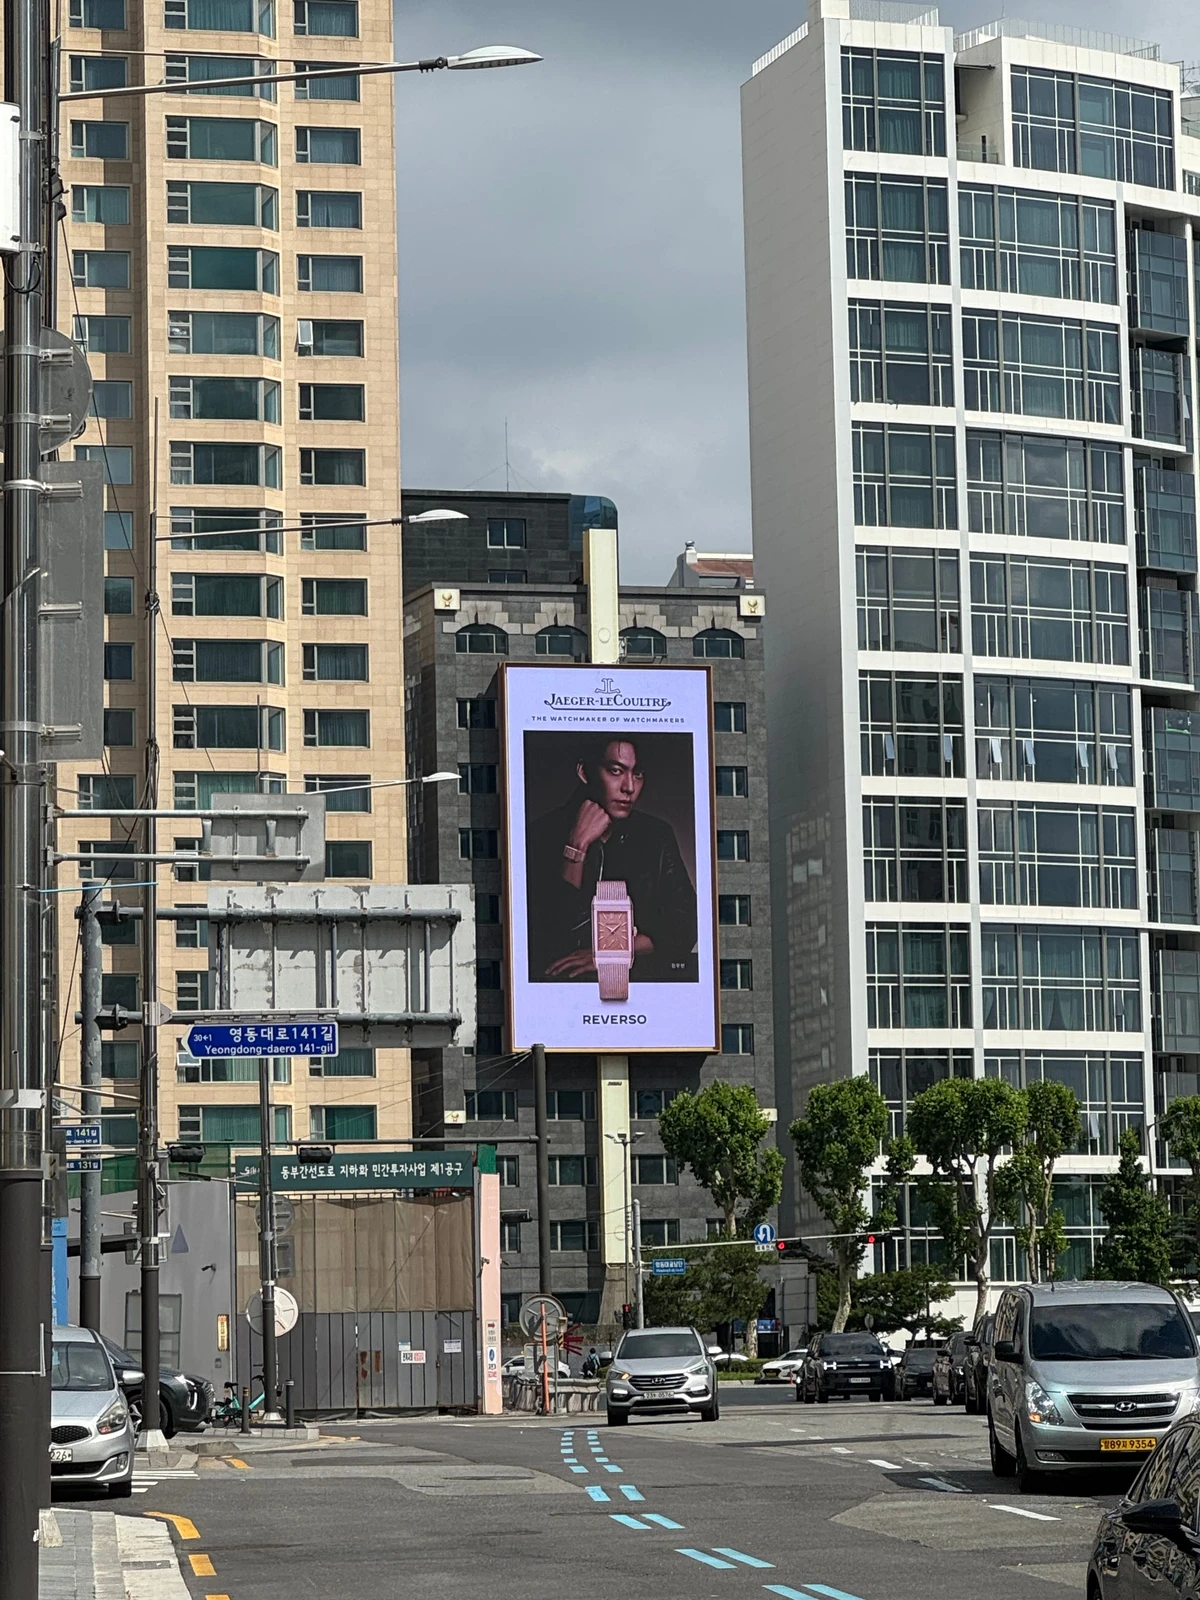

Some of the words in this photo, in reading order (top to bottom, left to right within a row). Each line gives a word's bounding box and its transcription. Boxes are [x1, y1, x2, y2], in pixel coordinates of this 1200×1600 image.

[582, 1014, 647, 1025] REVERSO
[229, 1026, 333, 1043] 영동대로141길
[204, 1045, 296, 1056] Yeongdong-daero
[299, 1043, 333, 1055] 141-gil
[280, 1164, 336, 1180] 동부간선도로
[340, 1163, 369, 1178] 지하화
[372, 1162, 426, 1178] 민간투자사업
[430, 1162, 464, 1177] 제1공구
